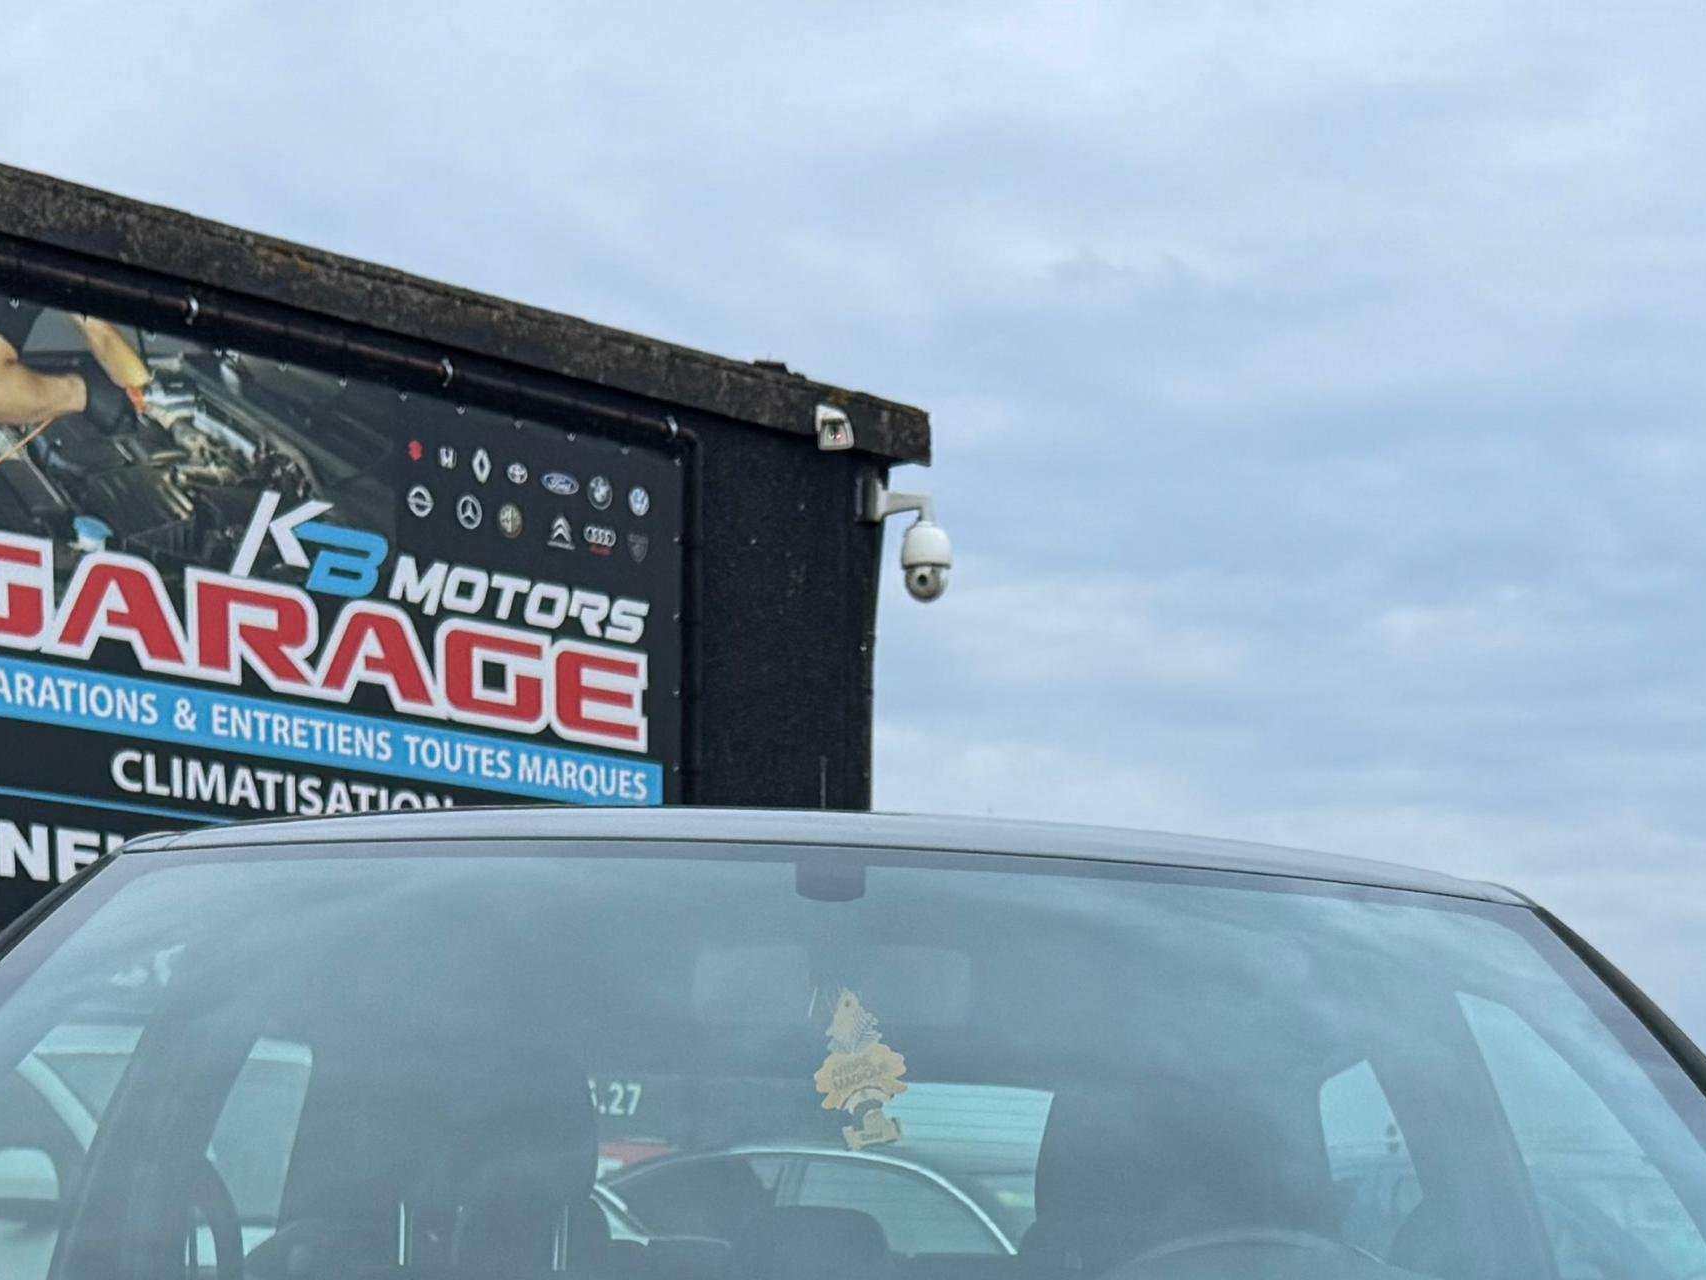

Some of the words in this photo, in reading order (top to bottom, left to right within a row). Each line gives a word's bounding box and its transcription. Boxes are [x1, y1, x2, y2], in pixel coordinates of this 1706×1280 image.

[230, 490, 389, 598] KB
[389, 553, 651, 645] MOTORS
[173, 697, 198, 734] &
[211, 702, 392, 763] ENTRETIENS
[404, 733, 512, 782] TOUTES
[517, 752, 648, 801] MARQUES
